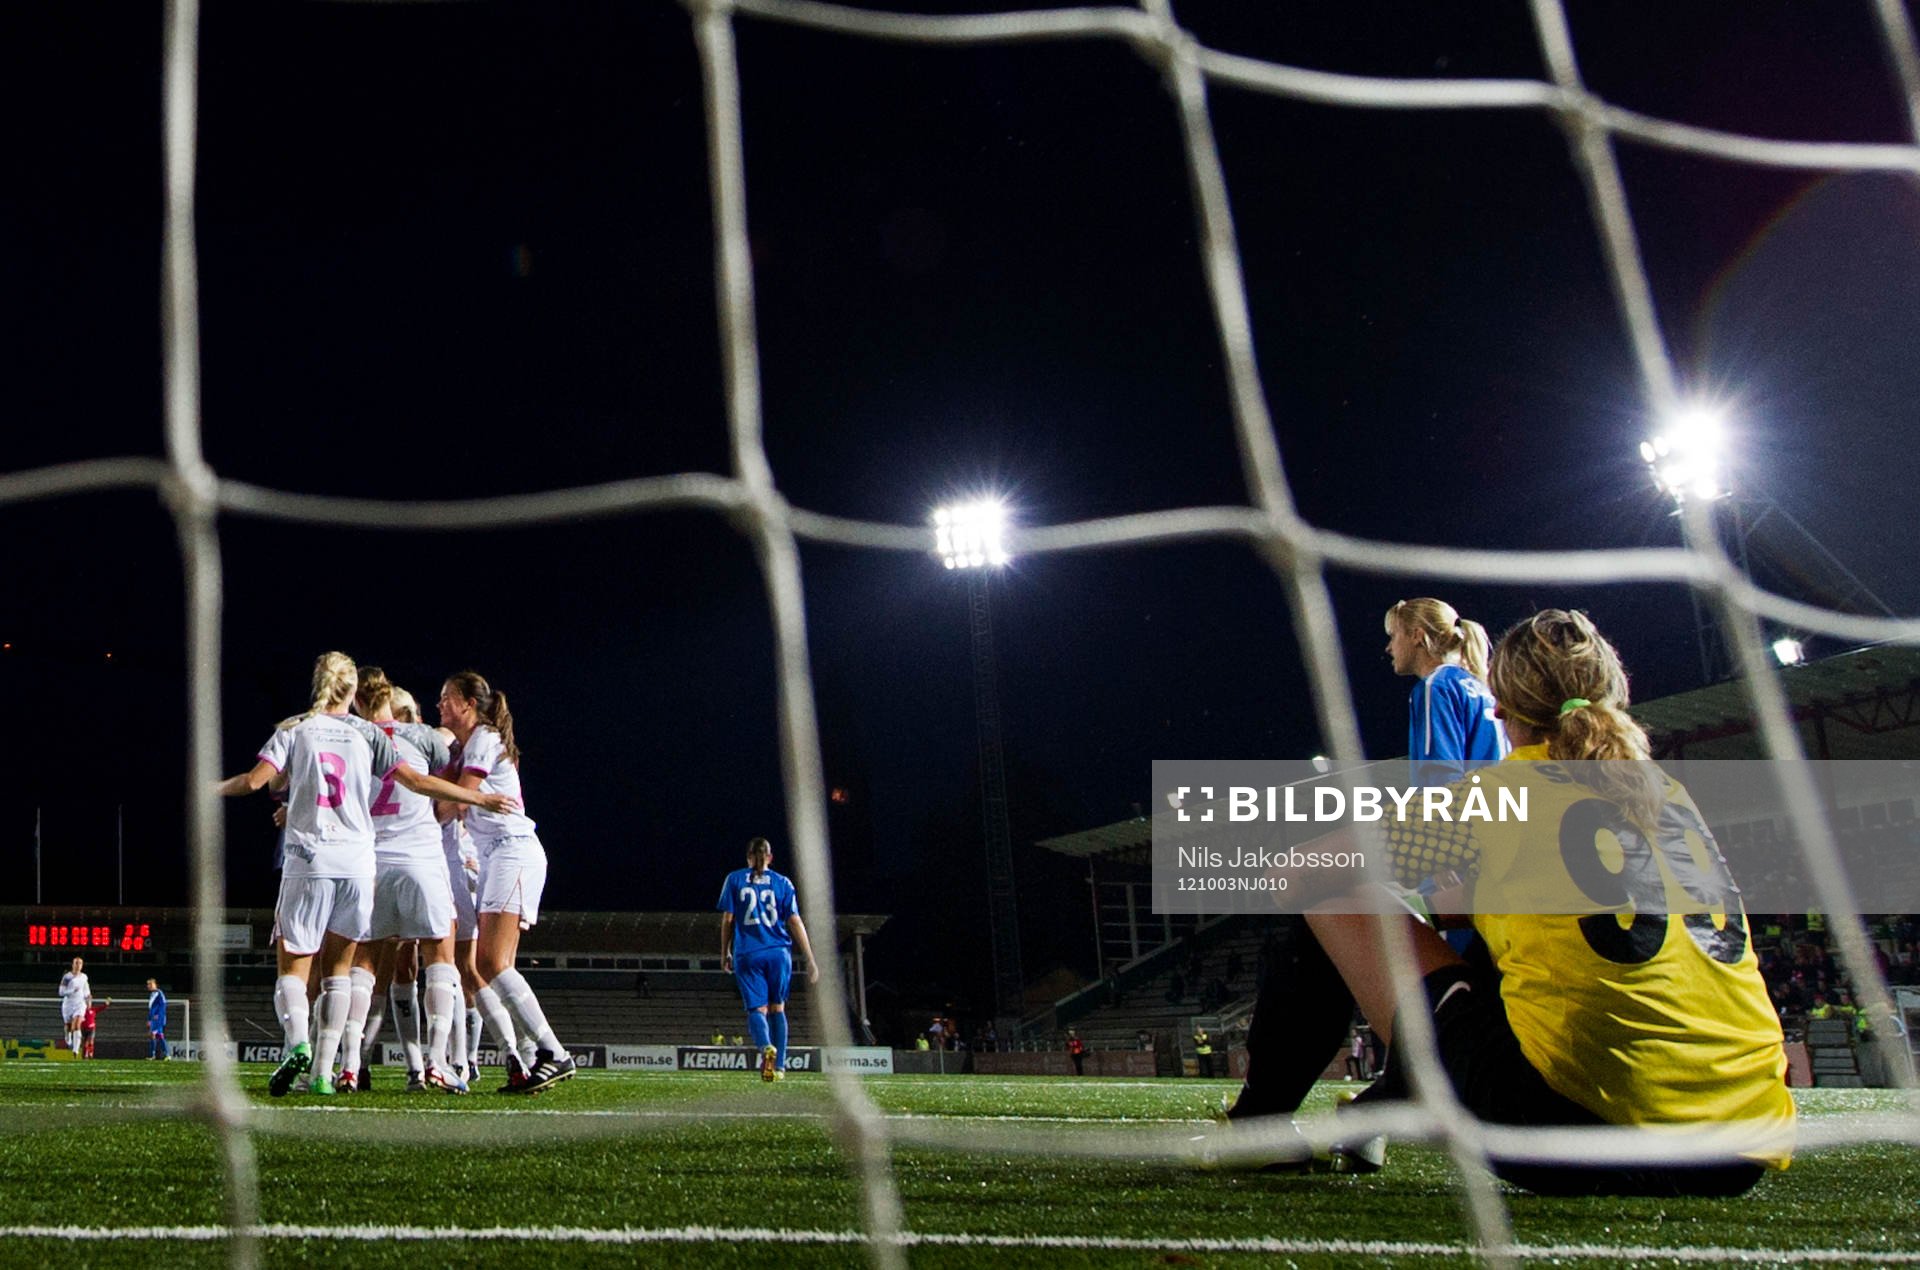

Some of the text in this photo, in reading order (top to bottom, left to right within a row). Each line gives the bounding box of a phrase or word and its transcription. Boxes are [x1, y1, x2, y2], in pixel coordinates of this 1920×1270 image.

[315, 751, 346, 809] 3
[1558, 798, 1746, 965] 99
[740, 886, 778, 928] 23
[243, 1046, 287, 1062] KER
[611, 1052, 673, 1065] kerma.se
[683, 1052, 748, 1069] KERMA
[827, 1055, 889, 1068] krma.se
